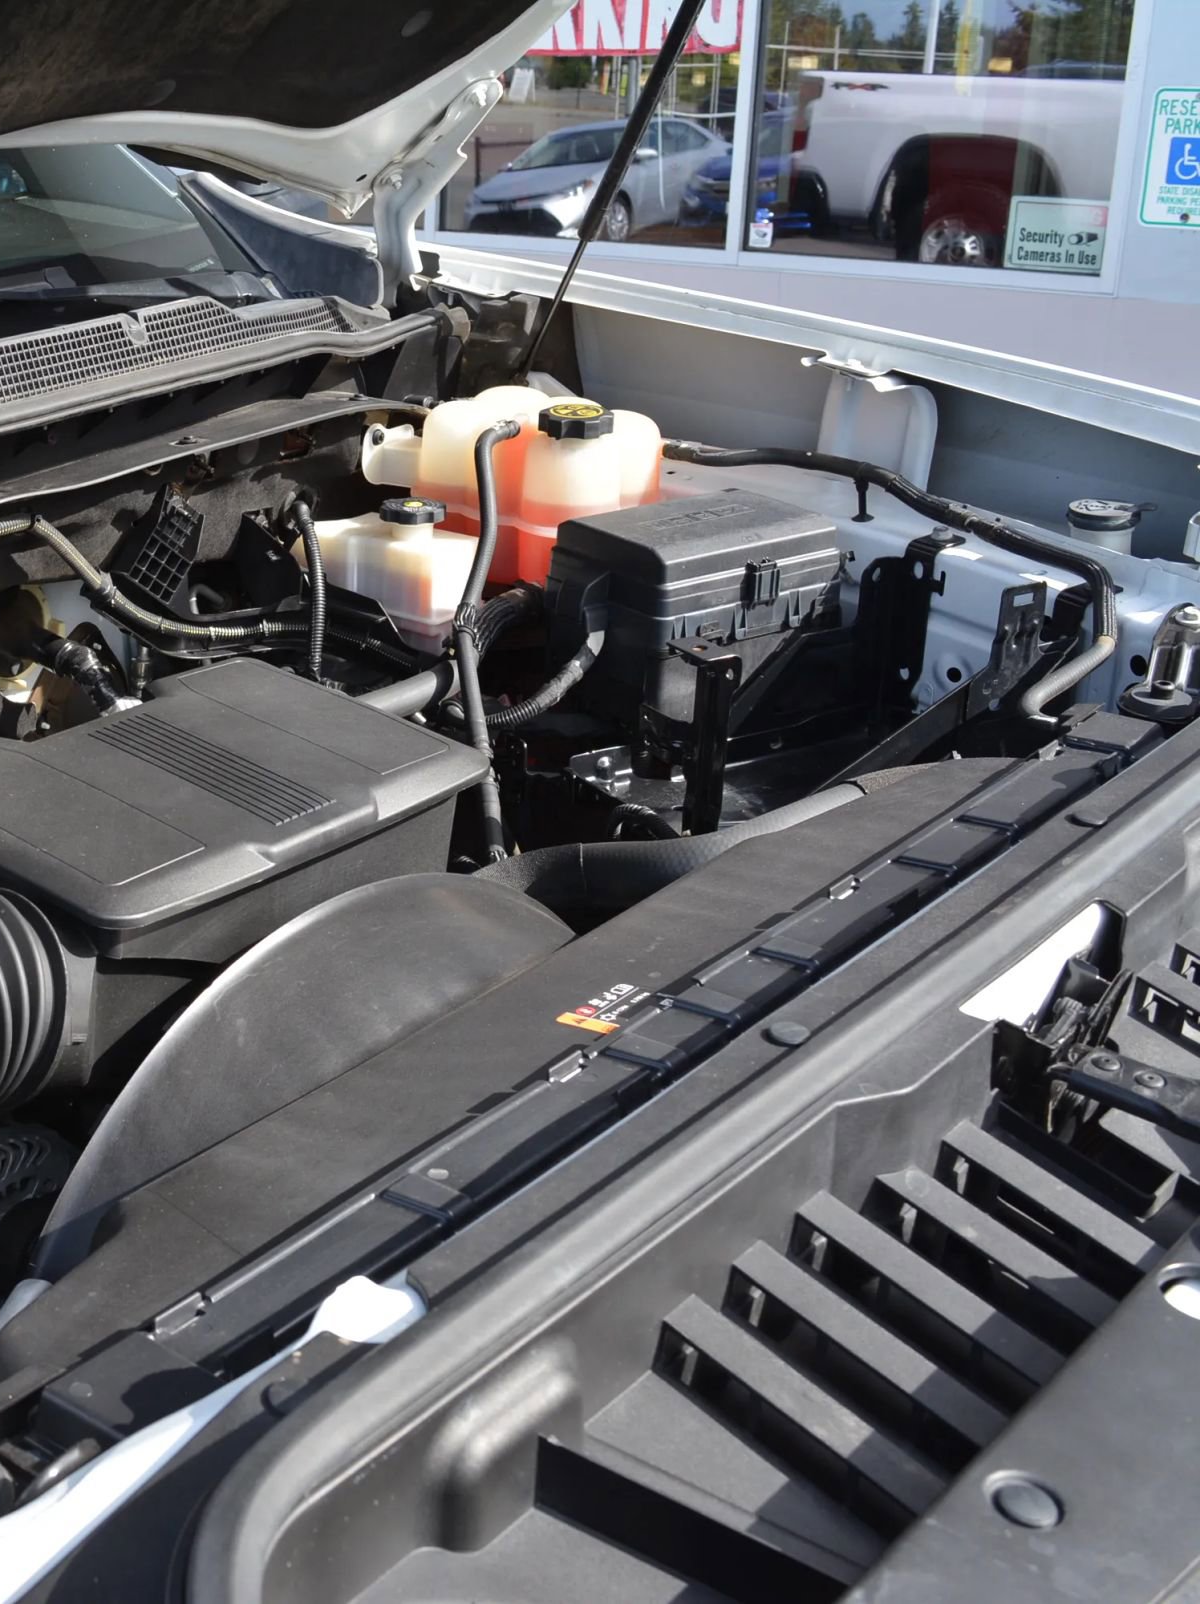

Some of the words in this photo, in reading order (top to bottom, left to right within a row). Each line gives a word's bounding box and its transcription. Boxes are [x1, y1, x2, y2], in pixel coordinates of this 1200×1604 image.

[1019, 227, 1065, 248] Security
[1017, 246, 1061, 263] Cameras
[1065, 249, 1075, 264] In
[1078, 250, 1097, 265] Use
